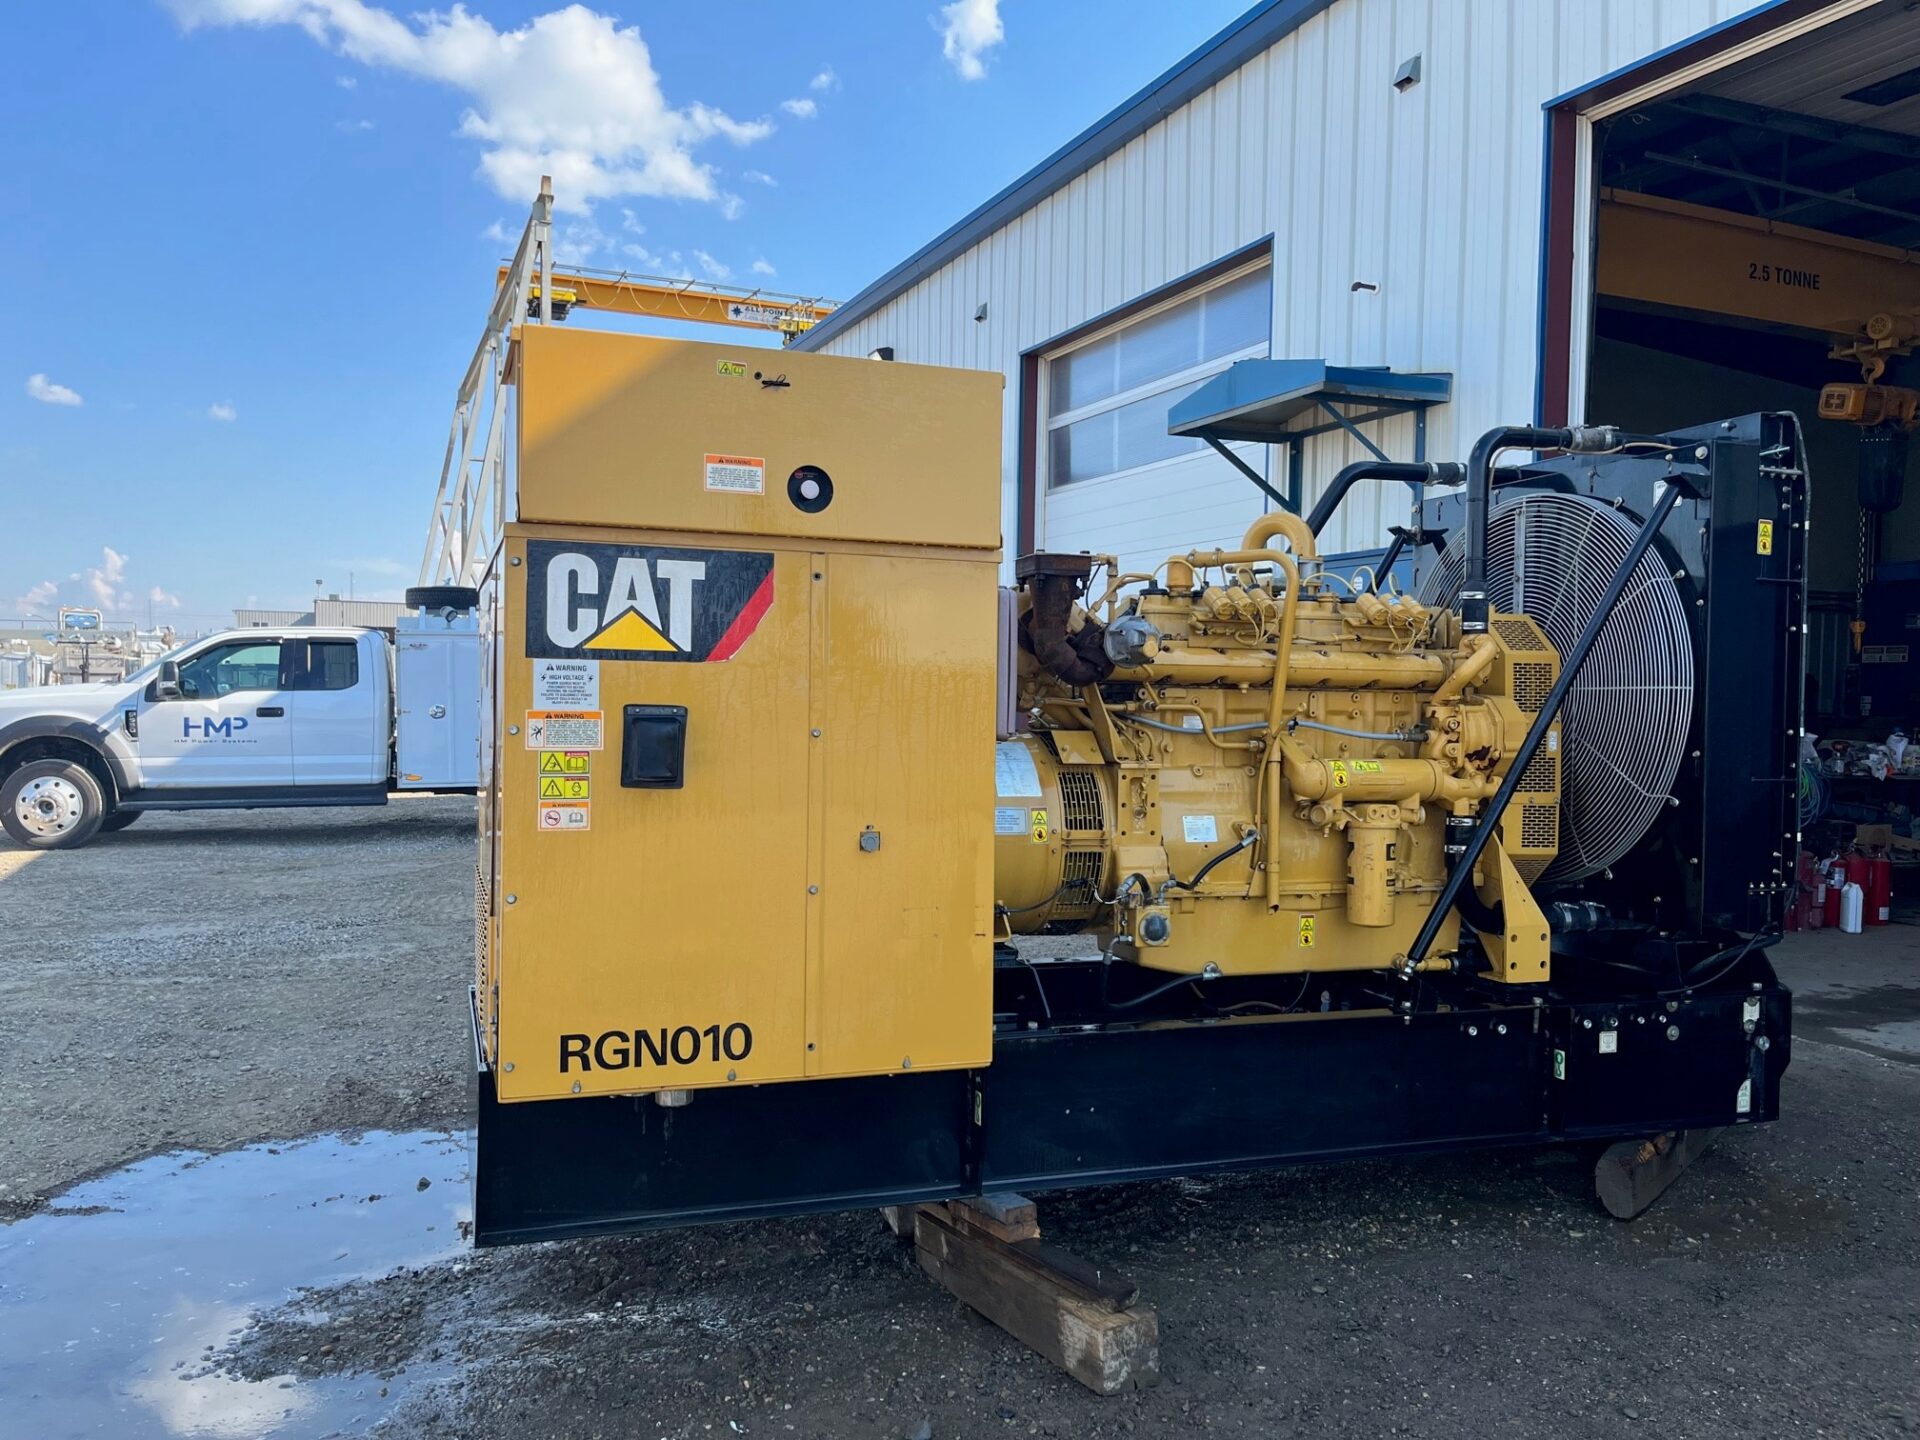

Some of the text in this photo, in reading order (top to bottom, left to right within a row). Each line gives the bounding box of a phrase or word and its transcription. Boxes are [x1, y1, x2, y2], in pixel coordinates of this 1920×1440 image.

[1749, 262, 1820, 290] 2.5 TONNE
[744, 305, 760, 314] ALL
[724, 458, 752, 466] WARNING
[546, 552, 706, 653] CAT
[555, 664, 588, 672] WARNING
[183, 717, 249, 738] HMP
[560, 1022, 753, 1073] RGN010
